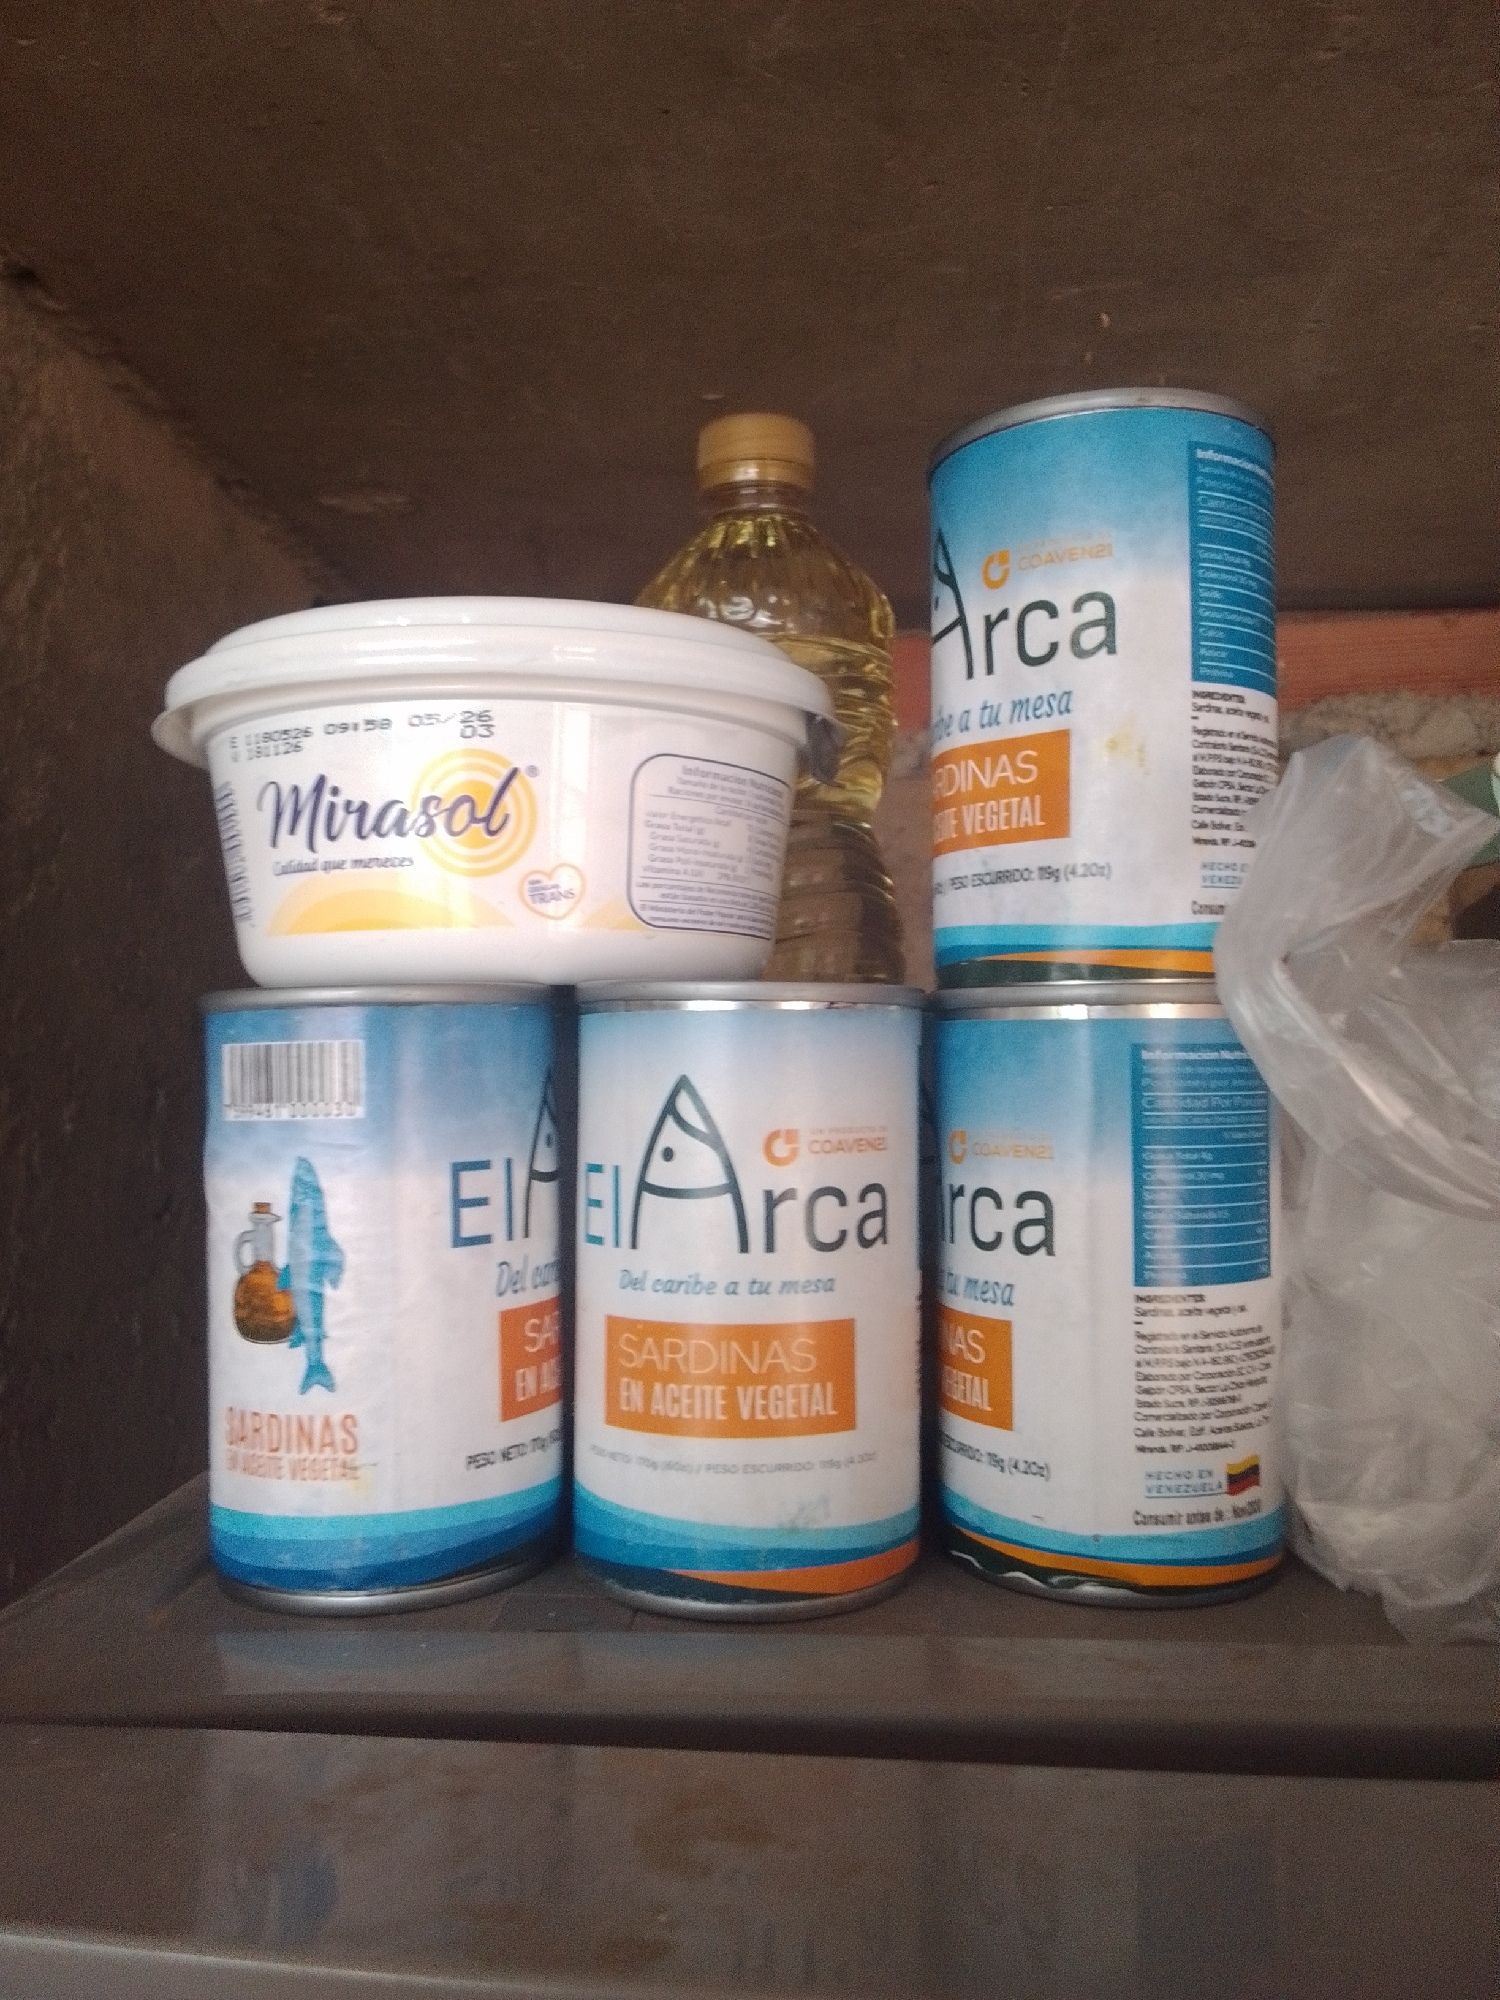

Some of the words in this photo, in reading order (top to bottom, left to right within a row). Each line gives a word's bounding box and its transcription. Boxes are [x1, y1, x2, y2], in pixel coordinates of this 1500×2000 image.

[958, 709, 972, 733] a
[979, 699, 1002, 729] tu
[1009, 689, 1073, 724] mesa
[256, 766, 521, 854] Mirasol
[961, 794, 1046, 836] VEGETAL
[320, 859, 347, 875] que
[583, 1162, 621, 1249] El
[629, 1073, 889, 1255] Arca
[449, 1156, 514, 1250] El
[941, 1183, 1056, 1258] rca
[496, 1253, 527, 1298] Del
[617, 1268, 648, 1292] Del
[651, 1273, 718, 1296] caribe
[723, 1281, 740, 1296] a
[747, 1277, 773, 1296] tu
[778, 1276, 836, 1295] mesa
[963, 1276, 1014, 1307] mesa
[617, 1333, 818, 1376] SARDINAS
[515, 1365, 538, 1402] EN
[618, 1377, 645, 1414] EN
[649, 1381, 728, 1420] ACEITE
[735, 1381, 839, 1421] VEGETAL
[225, 1405, 359, 1456] SARDINAS
[1145, 1470, 1194, 1481] HECHO
[1145, 1479, 1223, 1494] VENEZUELA
